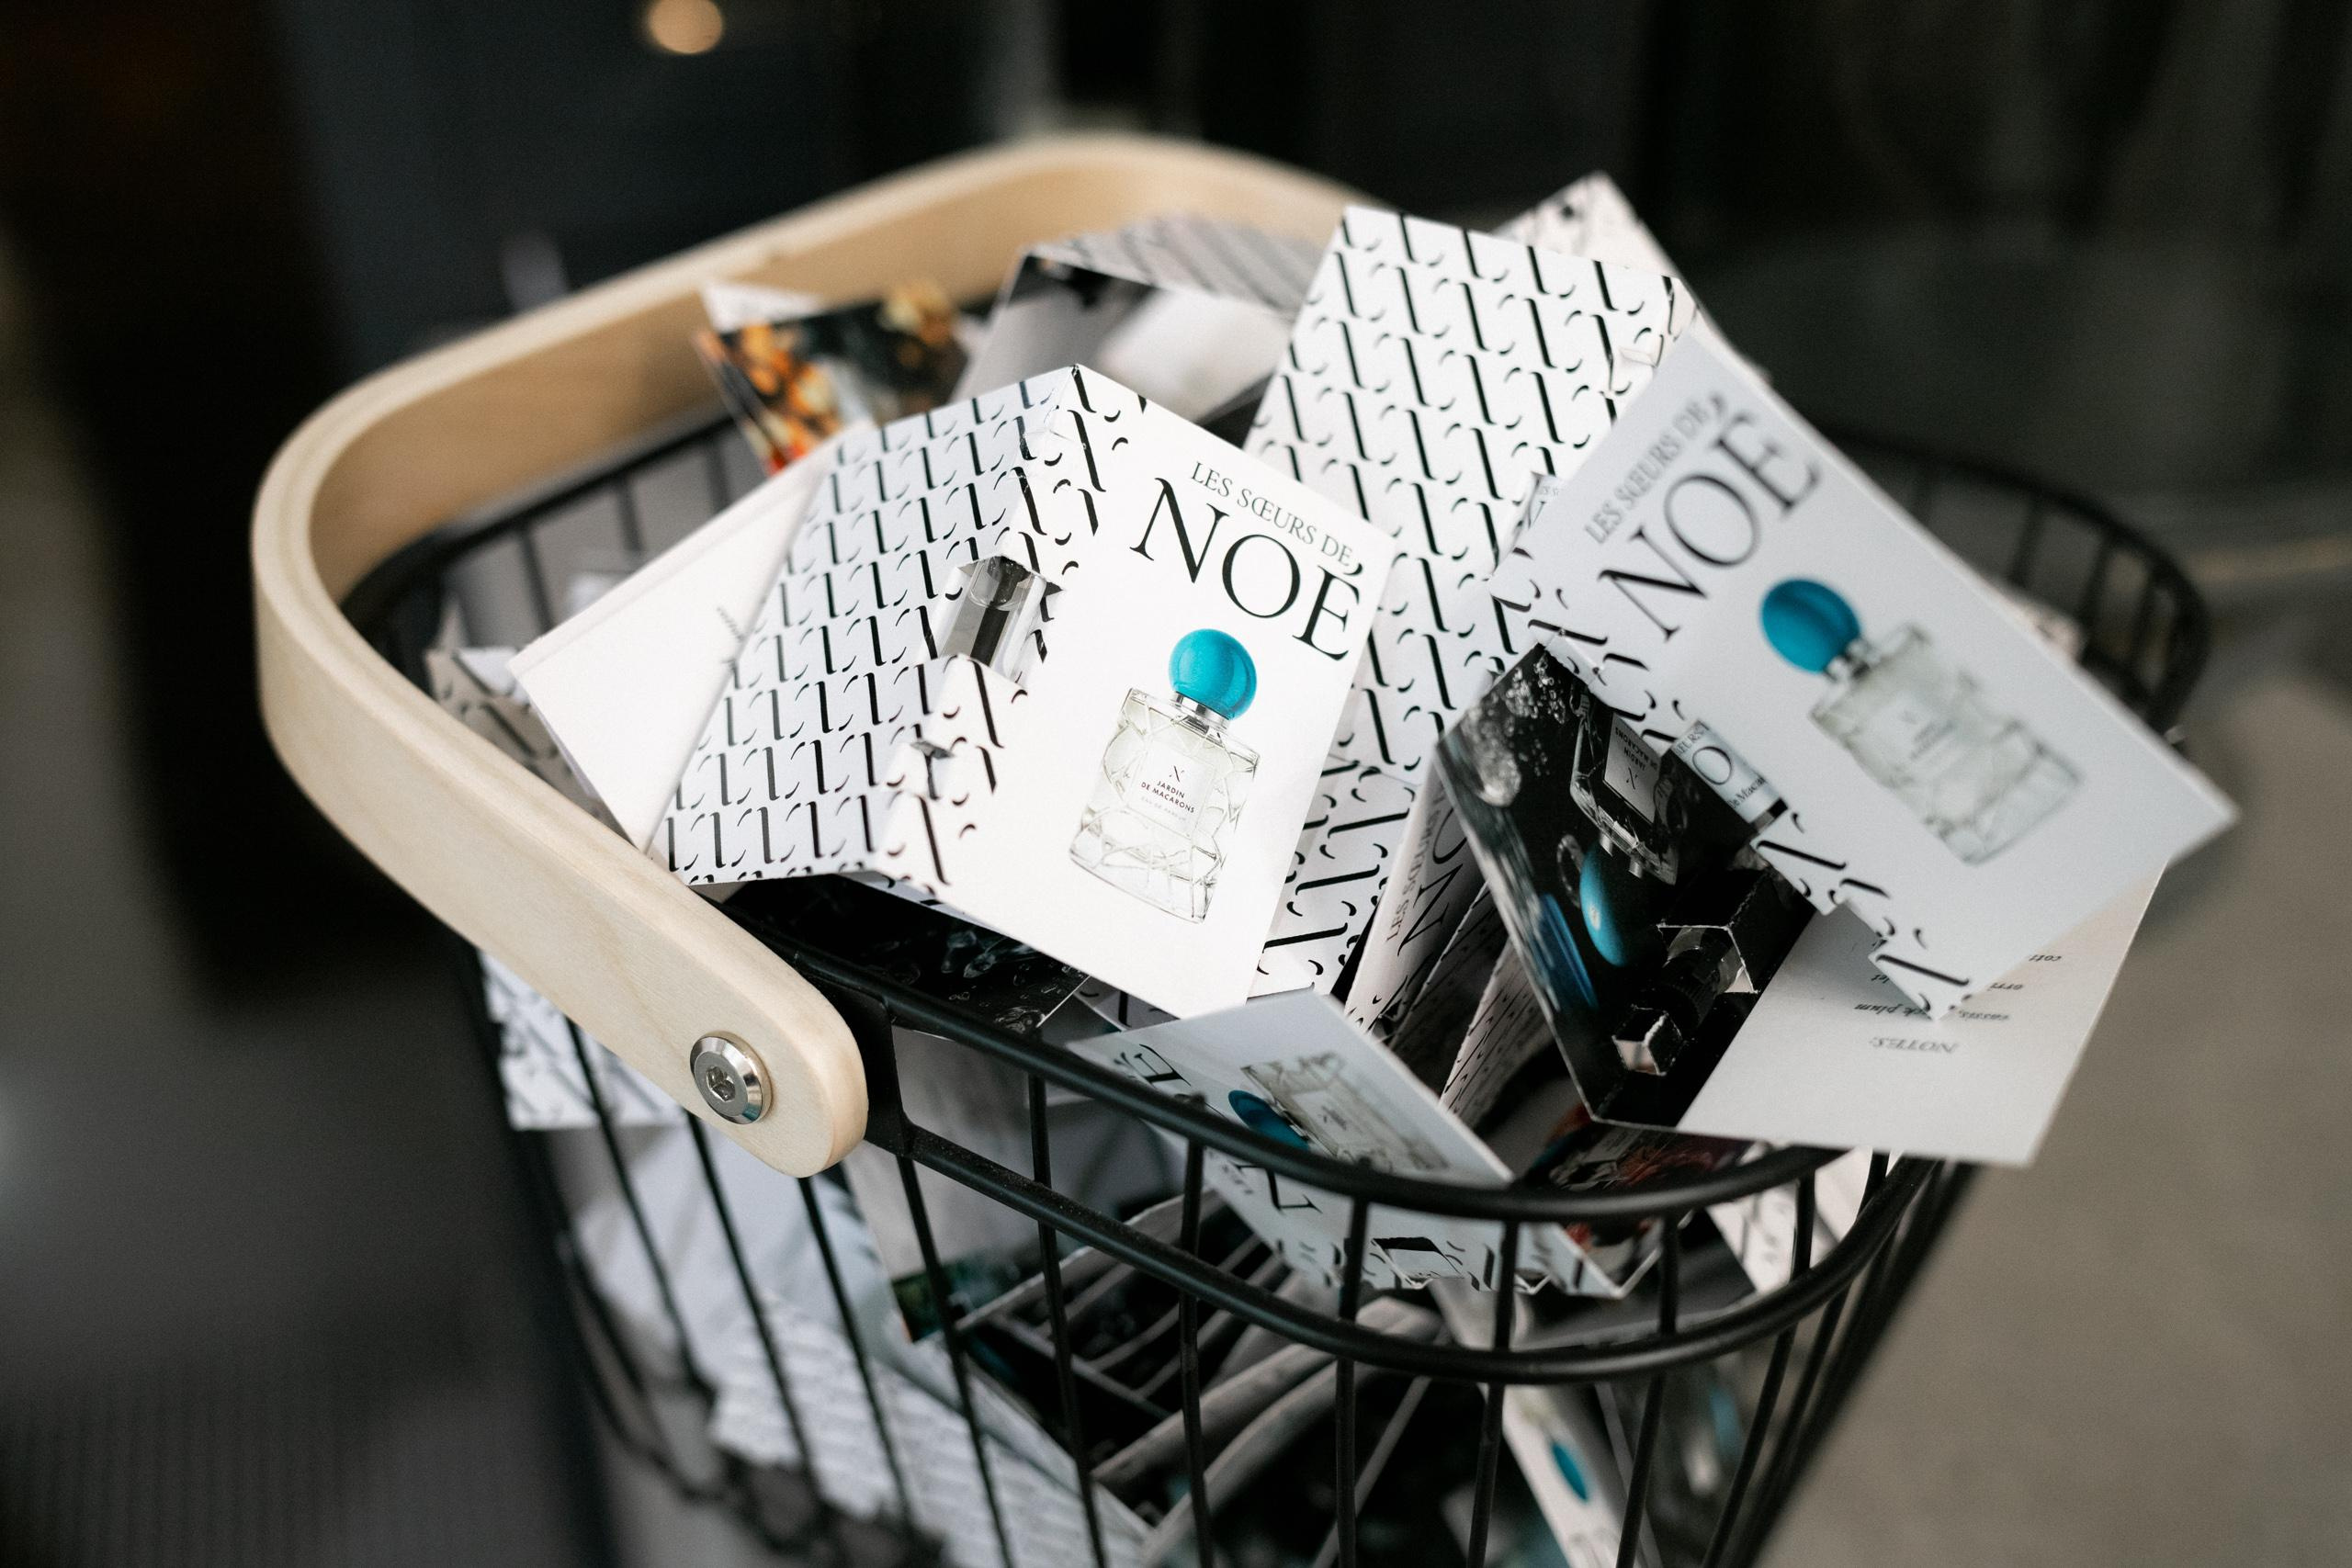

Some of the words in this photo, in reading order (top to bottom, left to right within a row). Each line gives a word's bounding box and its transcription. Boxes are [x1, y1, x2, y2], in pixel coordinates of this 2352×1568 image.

[1191, 461, 1233, 498] LES
[1237, 488, 1317, 545] SŒURS
[1320, 535, 1352, 567] DE
[1584, 504, 1624, 545] LES
[1129, 477, 1364, 661] NOÉ
[1140, 781, 1150, 791] DE
[1152, 787, 1195, 814] MACARONS
[1157, 780, 1185, 799] JARDIN
[1396, 807, 1468, 957] NO
[1386, 899, 1409, 942] LES
[1854, 1003, 1905, 1016] plum
